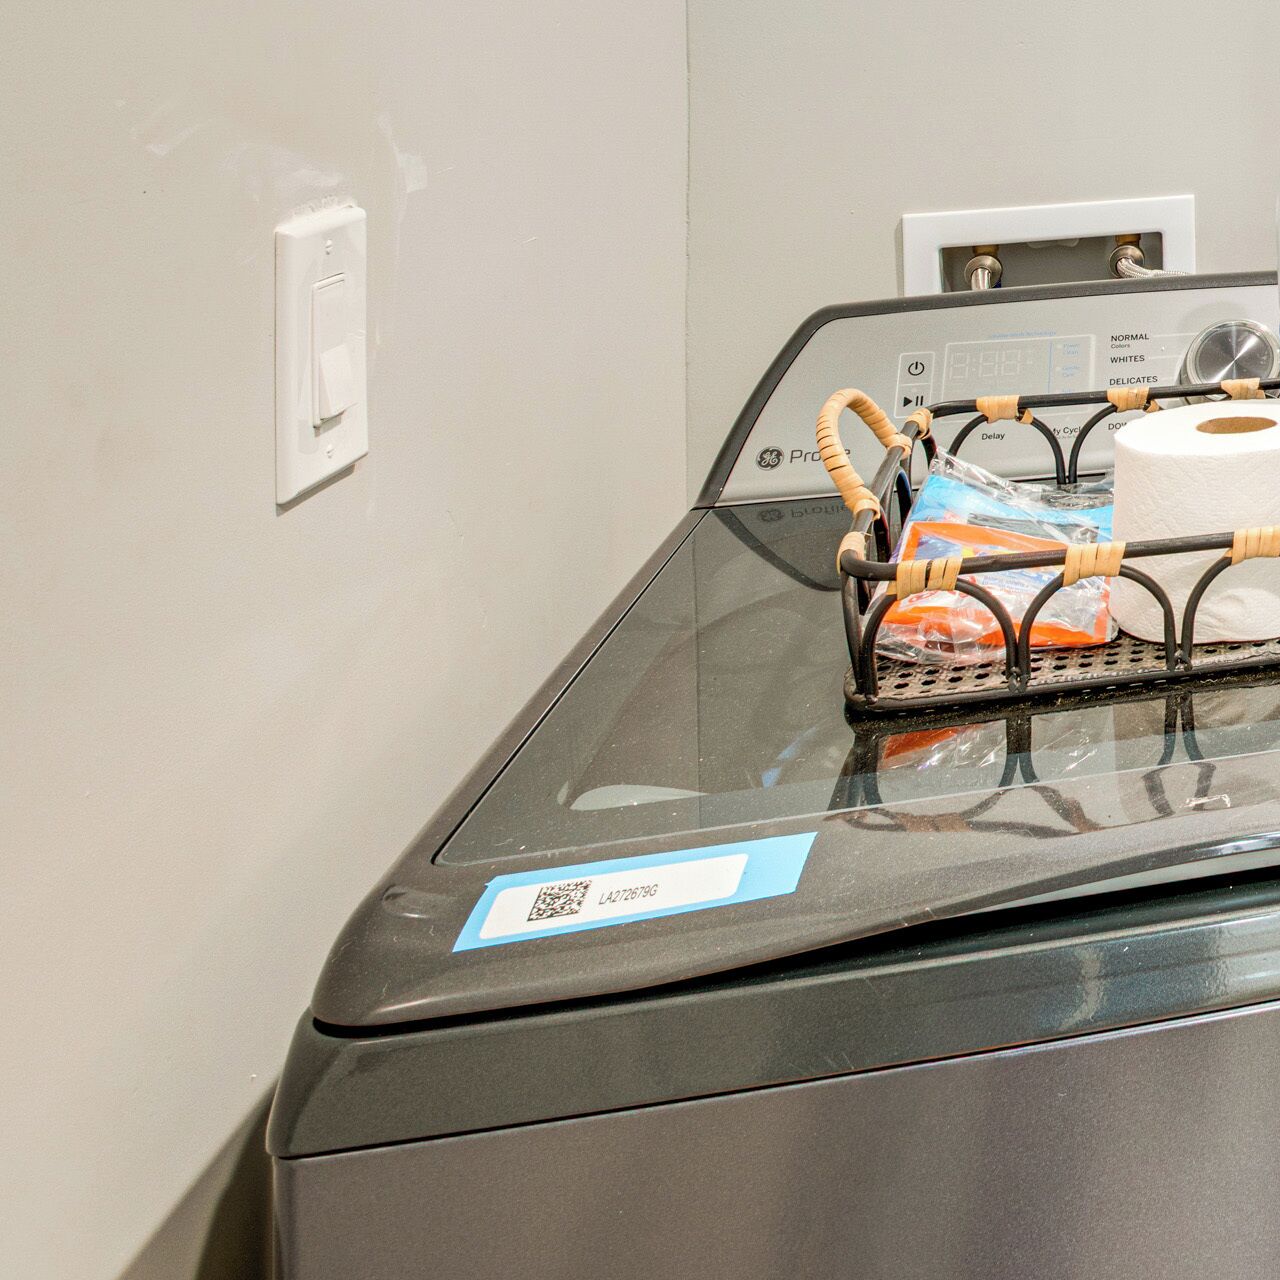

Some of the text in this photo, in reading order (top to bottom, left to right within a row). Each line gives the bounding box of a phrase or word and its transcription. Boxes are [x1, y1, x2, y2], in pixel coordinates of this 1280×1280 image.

[1110, 333, 1150, 342] NORMAL
[1110, 355, 1145, 364] WHITES
[1109, 375, 1158, 386] DELICATES
[1063, 426, 1081, 435] Cycl
[981, 431, 1006, 441] Delay
[599, 883, 659, 905] LA272679G
